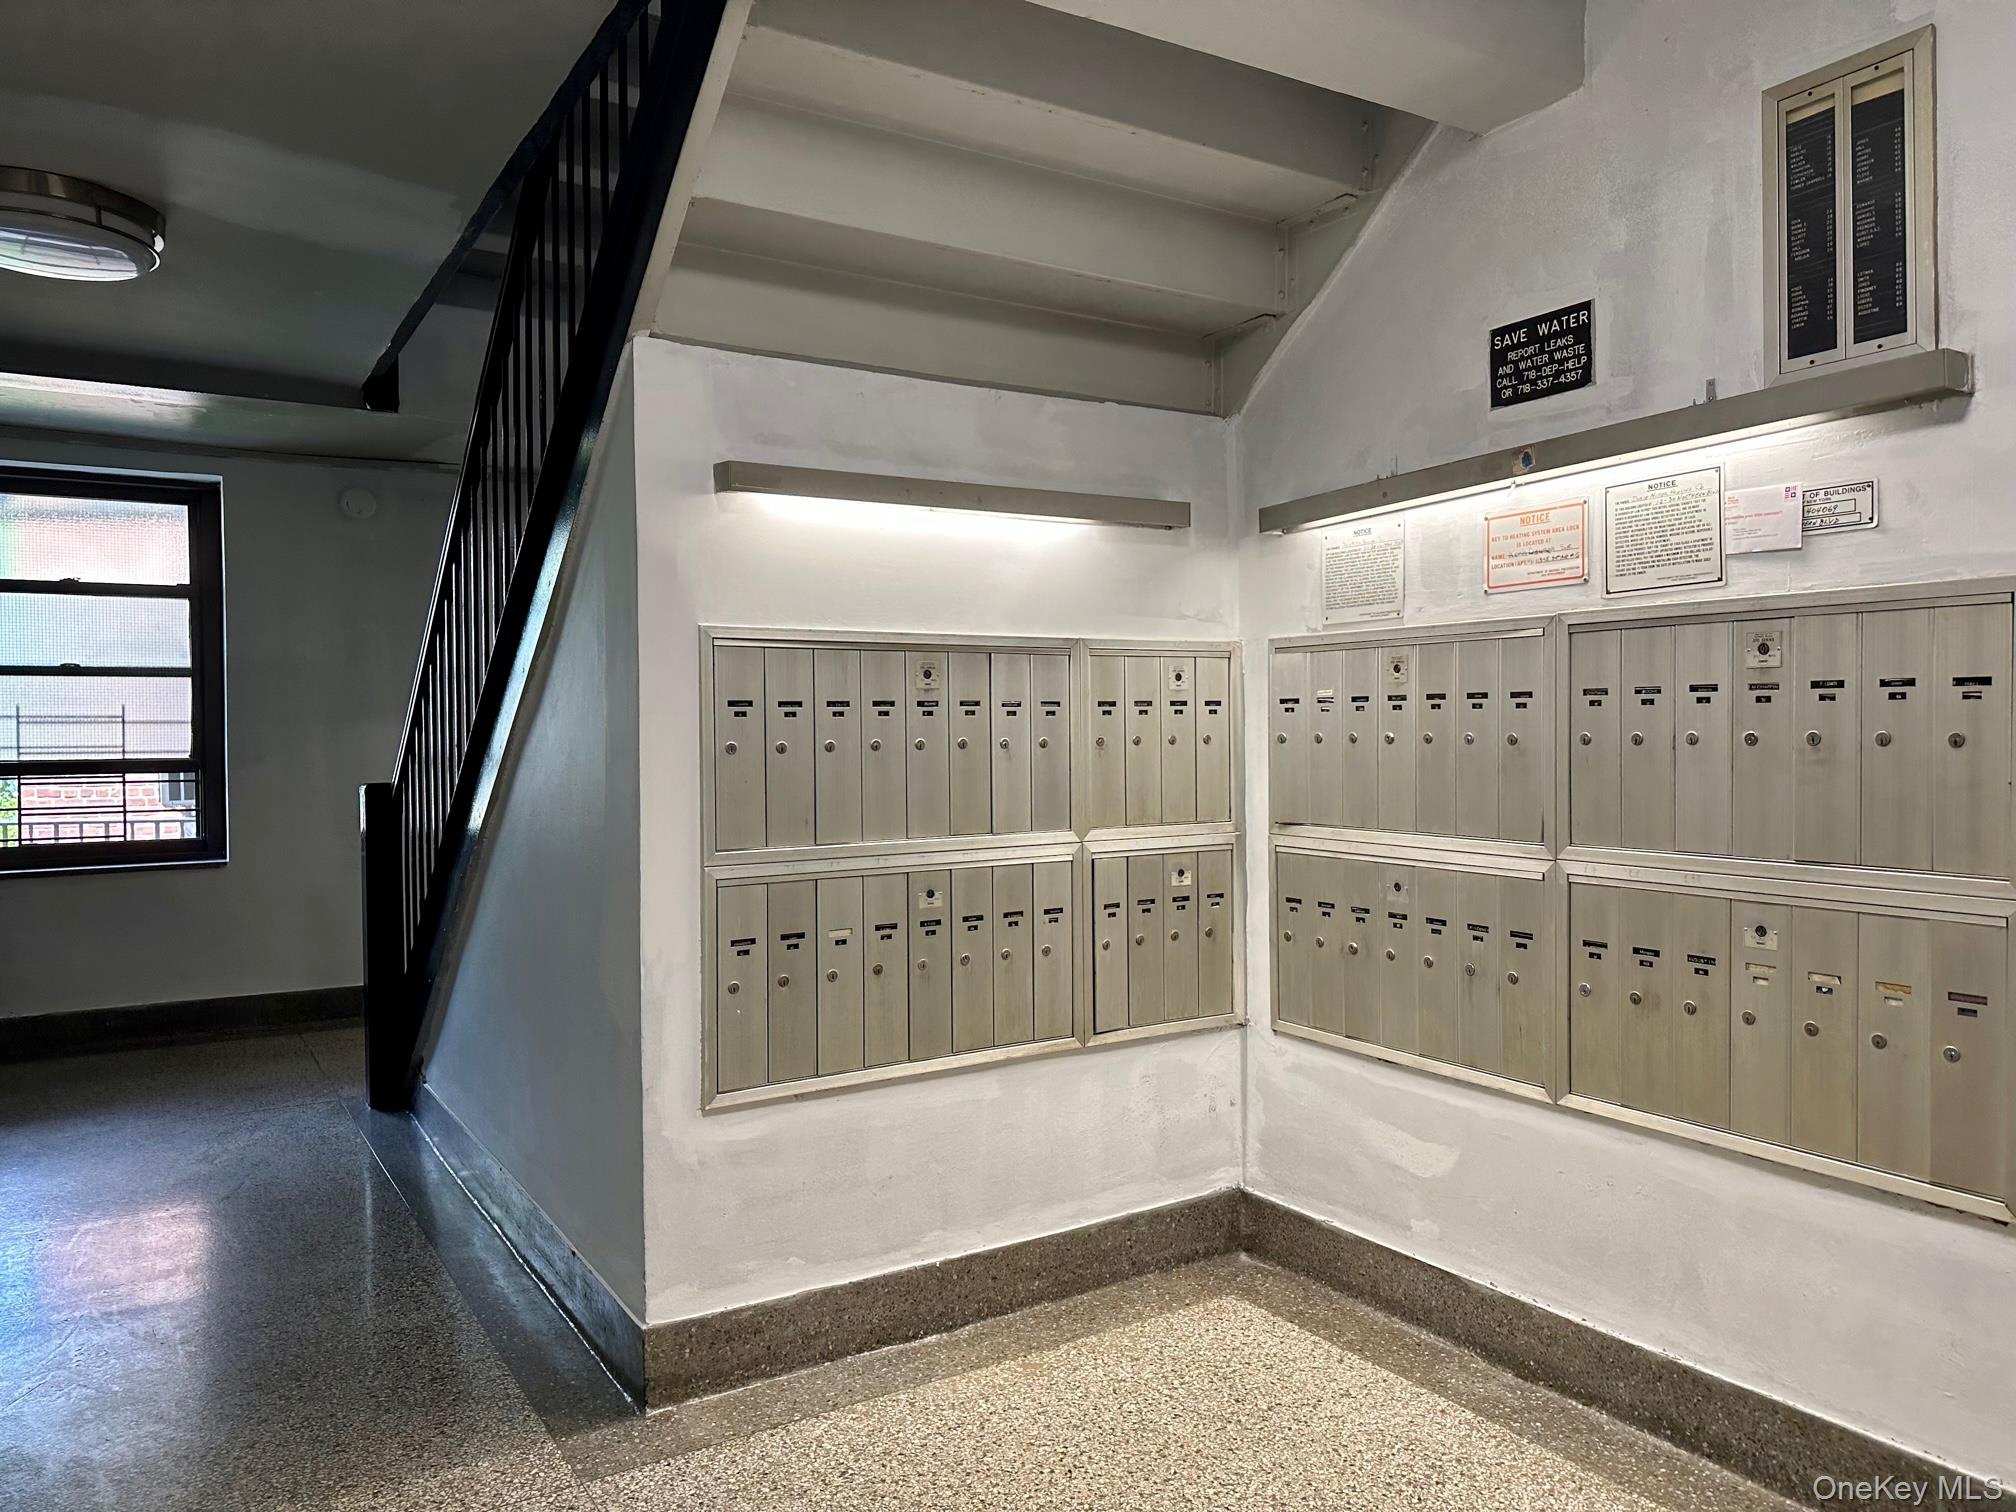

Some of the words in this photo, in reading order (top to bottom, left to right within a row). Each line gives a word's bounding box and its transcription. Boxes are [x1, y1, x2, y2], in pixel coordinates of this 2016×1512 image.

[1494, 328, 1528, 349] SAVE
[1537, 310, 1589, 337] WATER
[1507, 344, 1540, 361] REPORT
[1544, 334, 1574, 351] LEAKS
[1497, 364, 1514, 376] AND
[1519, 354, 1549, 370] WATER
[1553, 343, 1586, 360] WASTE
[1496, 376, 1518, 388] CALL
[1522, 356, 1588, 381] 718-DEP-HELP
[1501, 388, 1513, 399] OR
[1517, 370, 1583, 395] 718-337-4357
[1648, 480, 1677, 490] NOTICE
[1809, 491, 1820, 499] OF
[1823, 484, 1867, 497] BUILDINGS
[1520, 512, 1551, 525] NOTICE
[1509, 532, 1530, 540] HEATING
[1522, 539, 1544, 547] LOCATED
